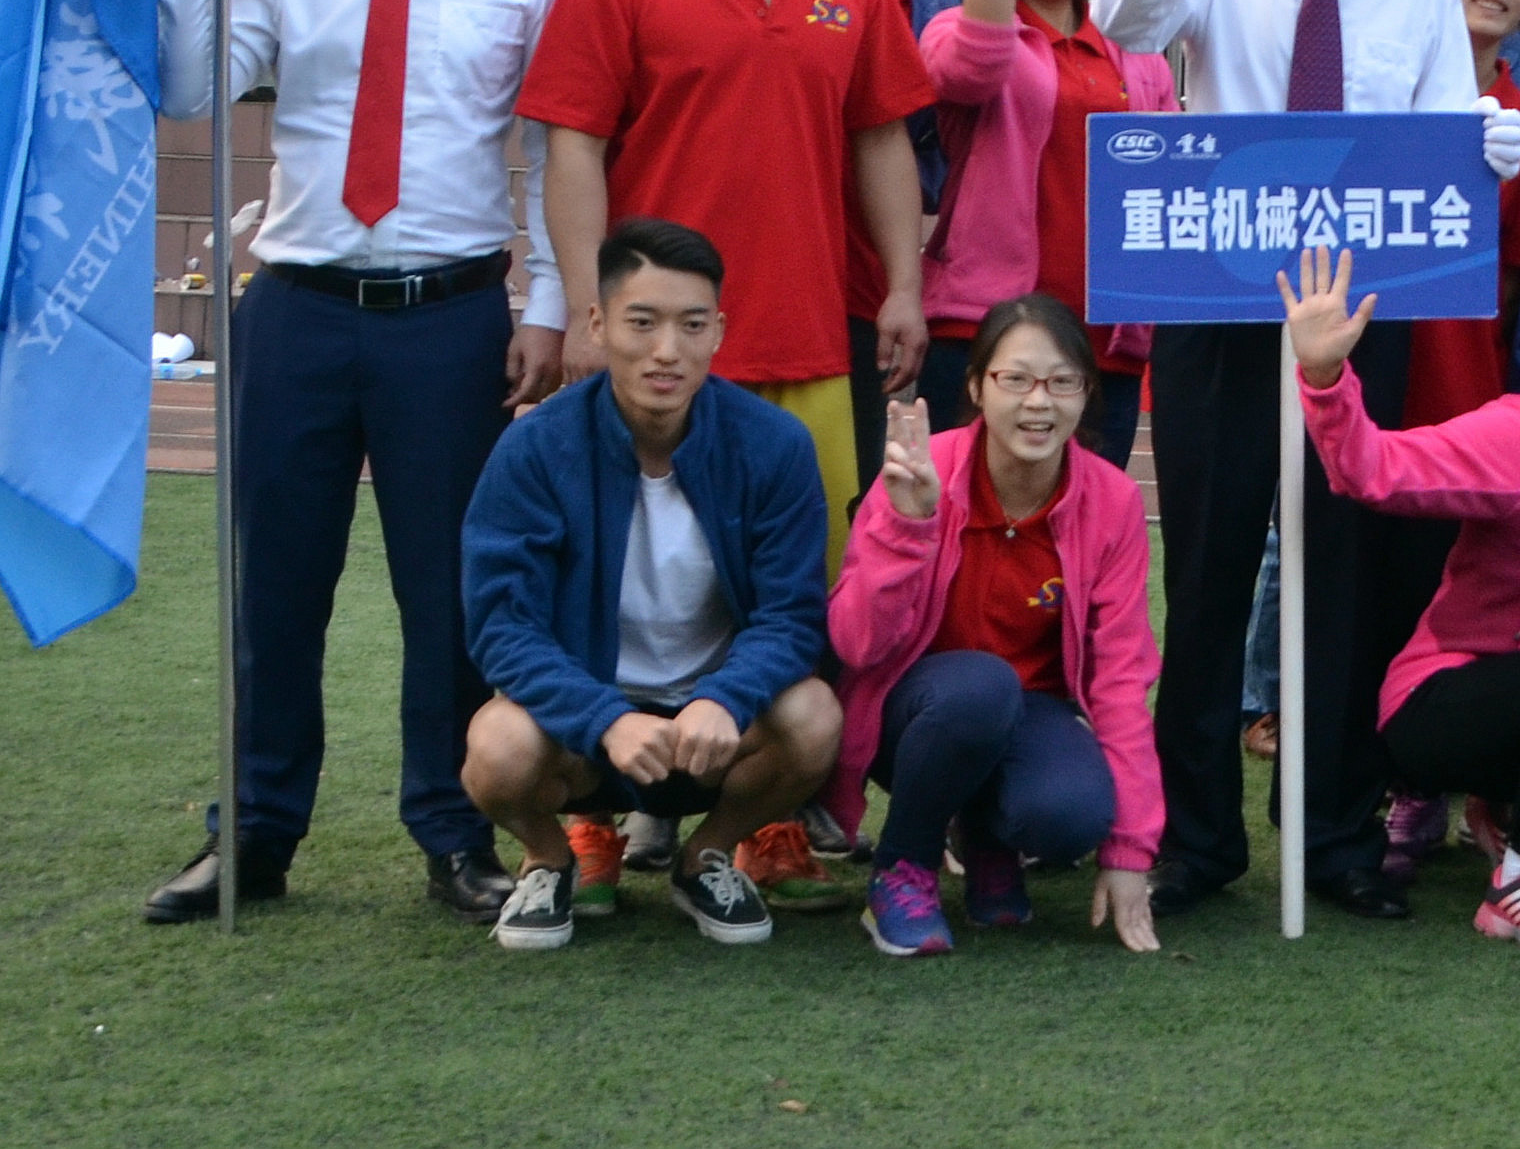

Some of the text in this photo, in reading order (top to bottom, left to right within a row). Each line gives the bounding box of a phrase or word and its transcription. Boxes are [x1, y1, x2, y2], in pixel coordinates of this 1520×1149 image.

[1114, 135, 1157, 149] CSIC
[1121, 185, 1472, 251] 重齿机械公司工会
